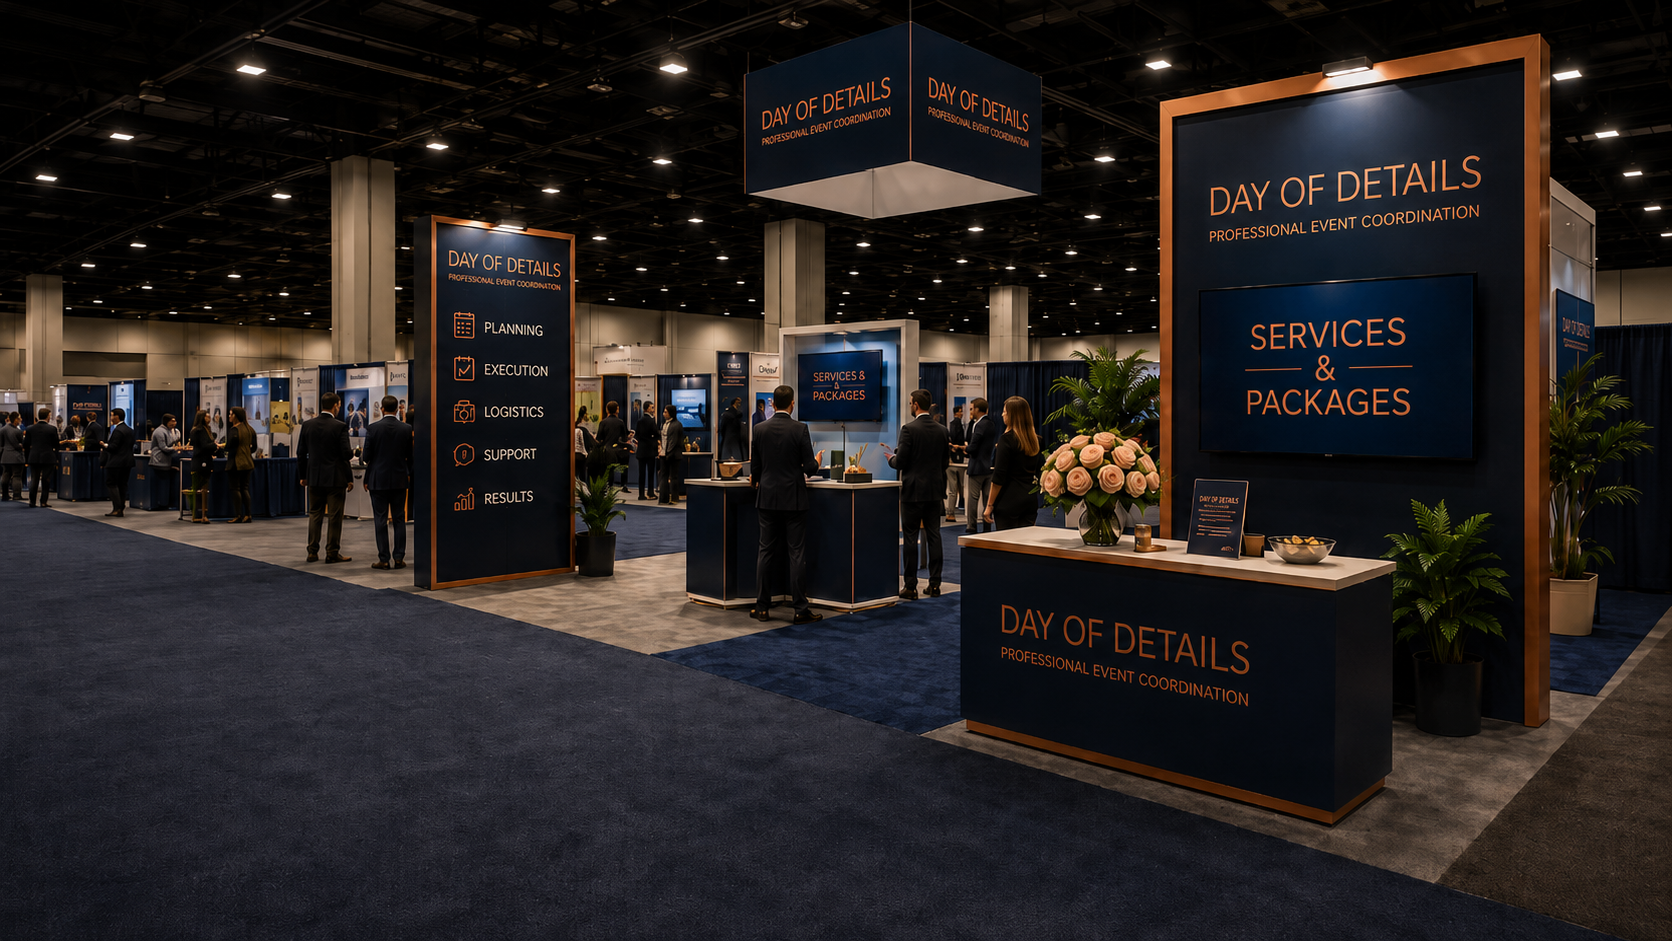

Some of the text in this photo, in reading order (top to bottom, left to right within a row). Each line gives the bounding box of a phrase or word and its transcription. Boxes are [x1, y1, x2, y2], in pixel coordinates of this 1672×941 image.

[762, 76, 892, 131] DAY OF DETAILS
[928, 76, 1029, 133] DAY OF DETAILS
[761, 106, 891, 146] PROFESSIONAL EVENT COORDINATION
[927, 106, 972, 130] PROFESSIONAL
[1210, 155, 1482, 216] DAY OF DETAILS
[1209, 204, 1480, 242] PROFESSIONAL EVENT COORDINATION
[448, 250, 561, 278] DAY OF DETAILS
[448, 273, 495, 285] PROFESSIONAL
[484, 321, 544, 337] PLANNING
[1250, 317, 1406, 350] SERVICES
[484, 363, 549, 377] EXECUTION
[813, 370, 857, 382] SERVICES
[1315, 354, 1336, 381] &
[813, 390, 866, 401] PACKAGES
[1247, 388, 1411, 416] PACKAGES
[484, 405, 544, 418] LOGISTICS
[484, 448, 537, 461] SUPPORT
[484, 490, 534, 505] RESULTS
[1001, 604, 1250, 675] DAY OF DETAILS
[1001, 646, 1249, 707] PROFESSIONAL EVENT COORDINATION
